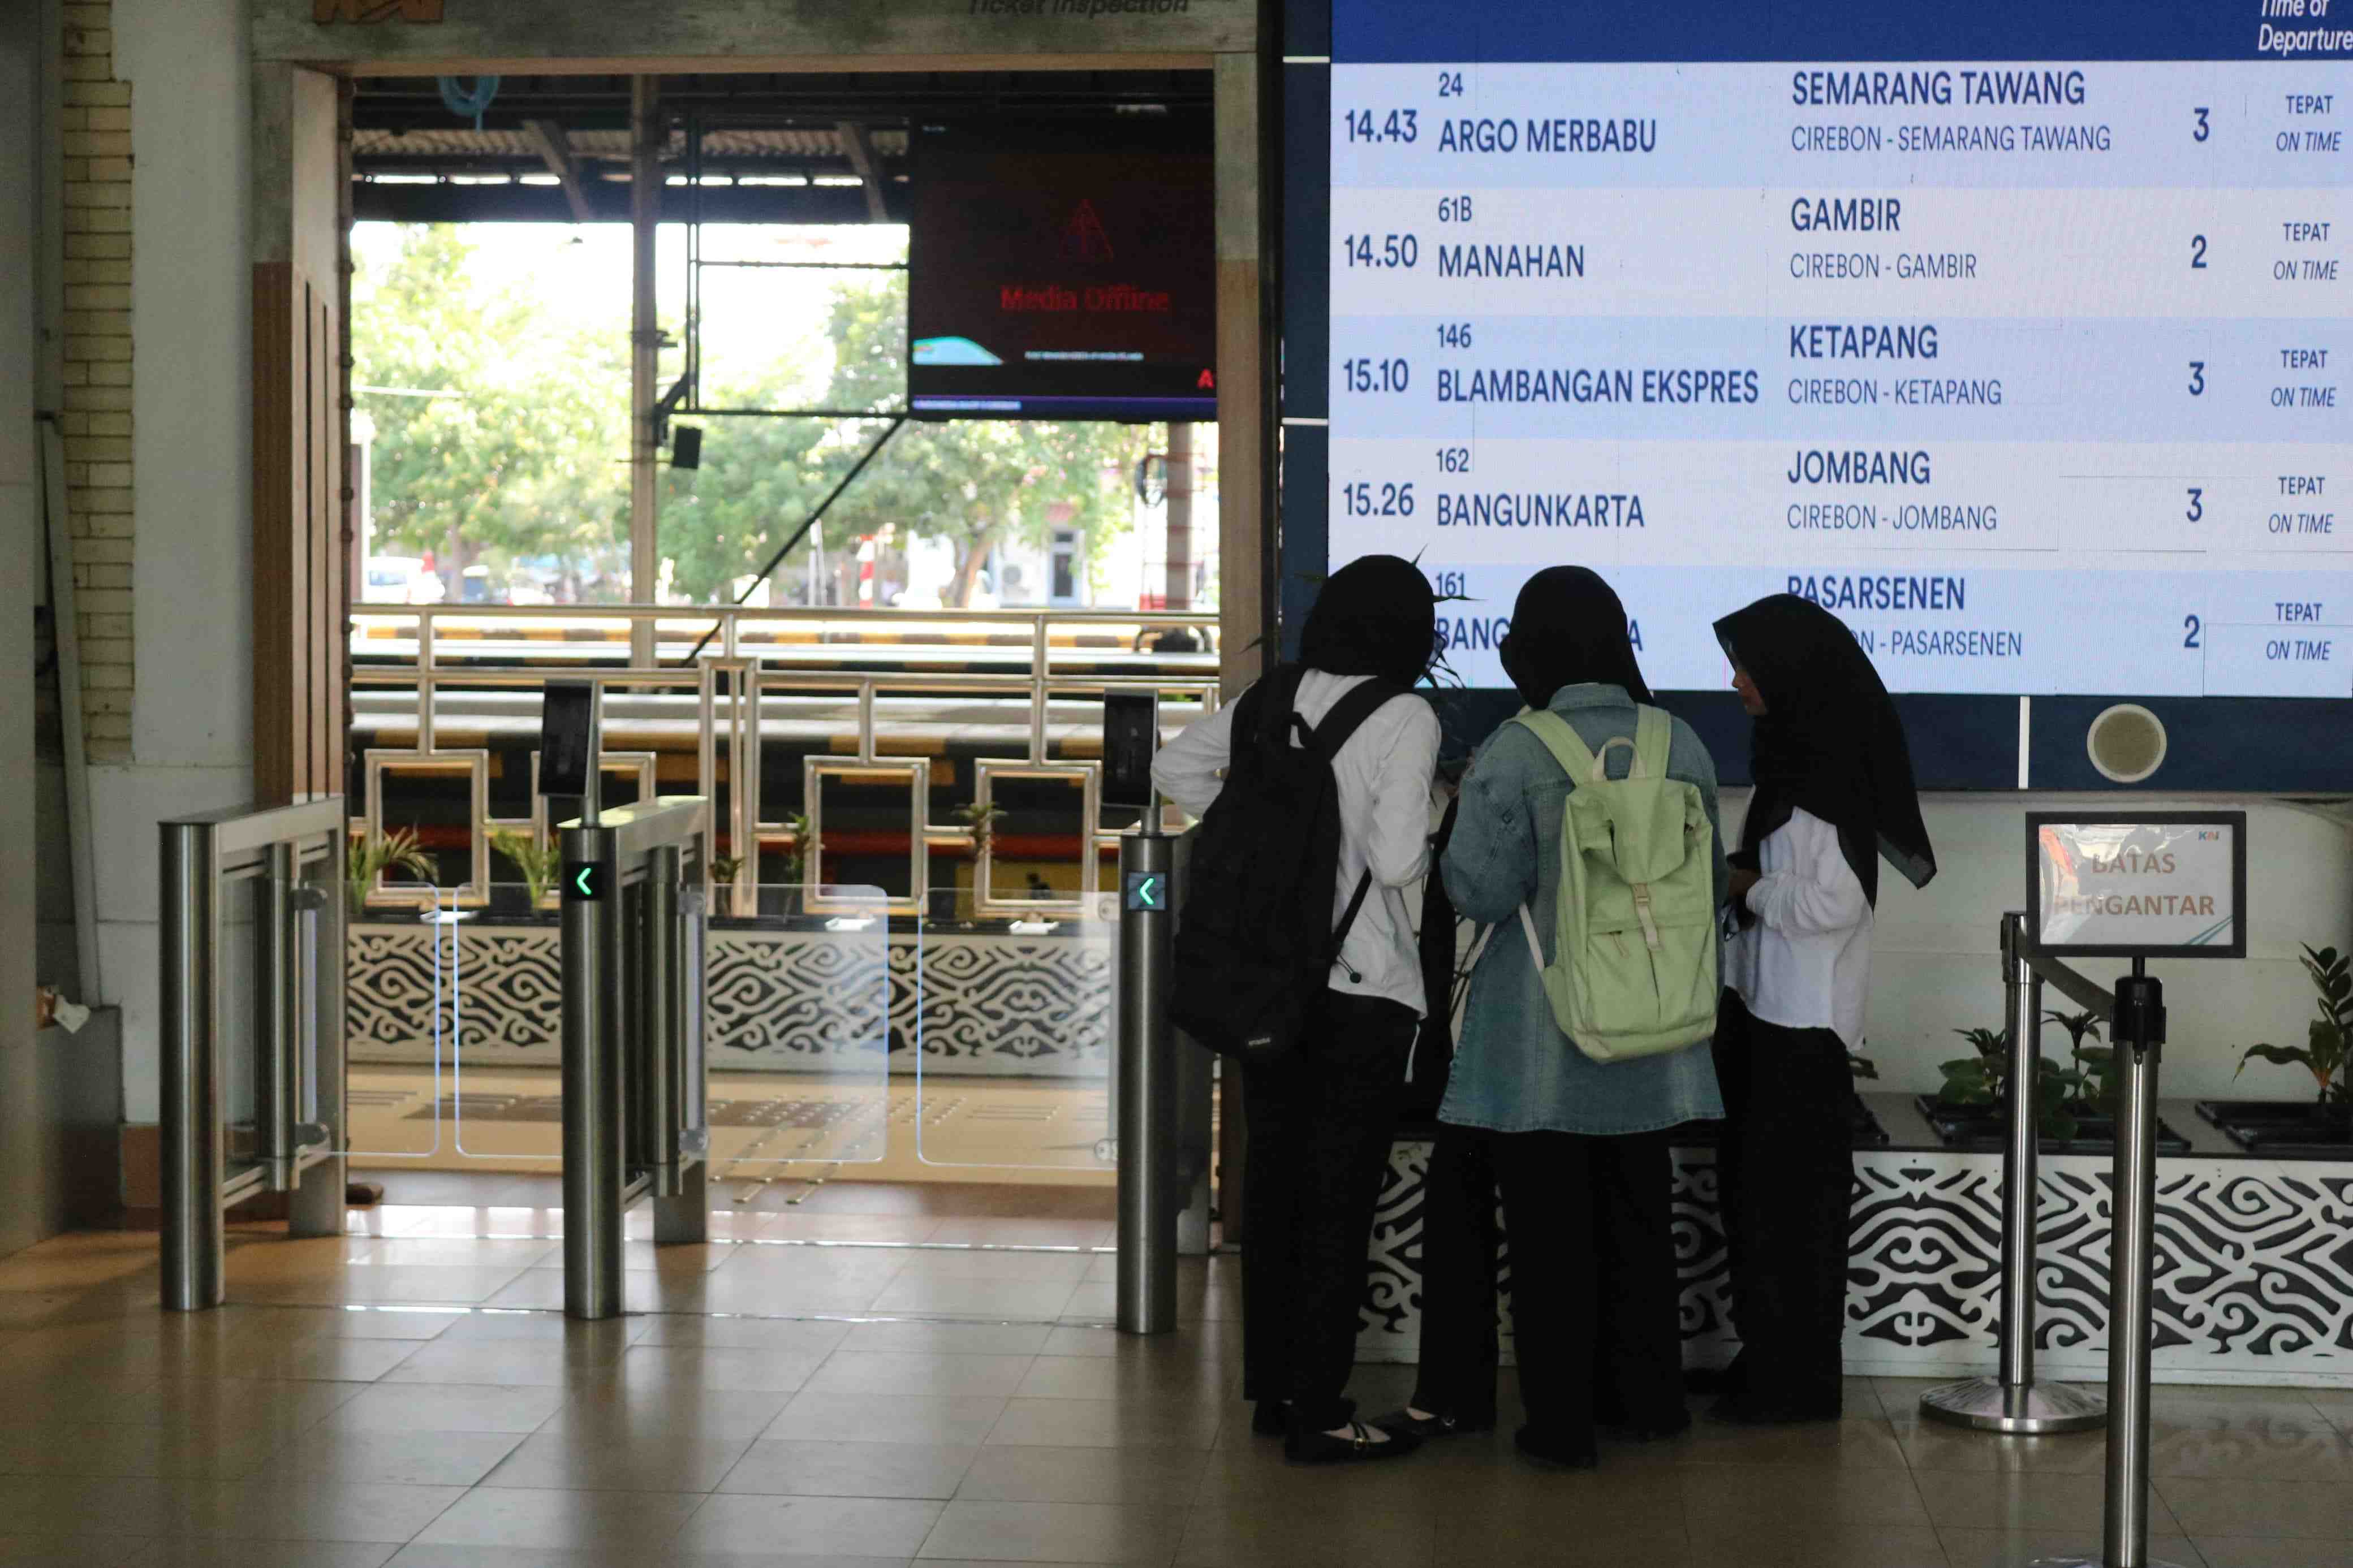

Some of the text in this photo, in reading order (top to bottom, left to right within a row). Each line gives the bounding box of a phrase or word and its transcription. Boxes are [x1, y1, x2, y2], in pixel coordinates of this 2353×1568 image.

[2258, 23, 2353, 57] Departure
[1438, 72, 1463, 97] 24
[1792, 70, 2085, 106] SEMARANG TAWANG
[2286, 95, 2334, 114] TEPAT
[1345, 109, 1656, 153] 14.43 ARGO MERBABU
[2193, 107, 2209, 142] 3
[1791, 126, 1881, 152] CIREBON
[1898, 125, 2014, 152] SEMARANG
[2020, 125, 2110, 151] TAWANG
[2276, 131, 2342, 152] ON TIME
[1438, 195, 1472, 222] 61B
[1791, 197, 1901, 231] GAMBIR
[2283, 222, 2331, 241] TEPAT
[1344, 234, 1584, 277] 14.50 MANAHAN
[2191, 234, 2207, 269] 2
[1790, 253, 1879, 279] CIREBON
[1897, 253, 1977, 279] GAMBIR
[2273, 260, 2339, 280] ON TIME
[1001, 284, 1169, 310] Media Offline
[1437, 323, 1472, 348] 146
[1790, 325, 1938, 359] KETAPANG
[2280, 349, 2328, 369] TEPAT
[1343, 358, 1759, 403] 15.10 BLAMBANGAN EKSPRES
[1789, 378, 1877, 405] CIREBON
[1895, 379, 2002, 405] KETAPANG
[2188, 361, 2204, 396] 3
[2271, 387, 2337, 408] ON TIME
[1436, 448, 1469, 473] 162
[1787, 450, 1930, 485] JOMBANG
[2278, 476, 2326, 495] TEPAT
[1343, 482, 1644, 527] 15.26 BANGUNKARTA
[1787, 504, 1876, 530] CIREBON
[1893, 504, 1997, 531] JOMBANG
[2186, 488, 2203, 522] 3
[2268, 513, 2334, 534] ON TIME
[1436, 572, 1466, 597] 161
[1787, 575, 1965, 610] PASARSENEN
[2275, 602, 2323, 621] TEPAT
[1891, 629, 2022, 656] PASARSENEN
[2184, 615, 2200, 649] 2
[2266, 640, 2332, 660] ON TIME
[2091, 853, 2176, 874] BATAS
[2054, 895, 2215, 915] PENGANTAR
